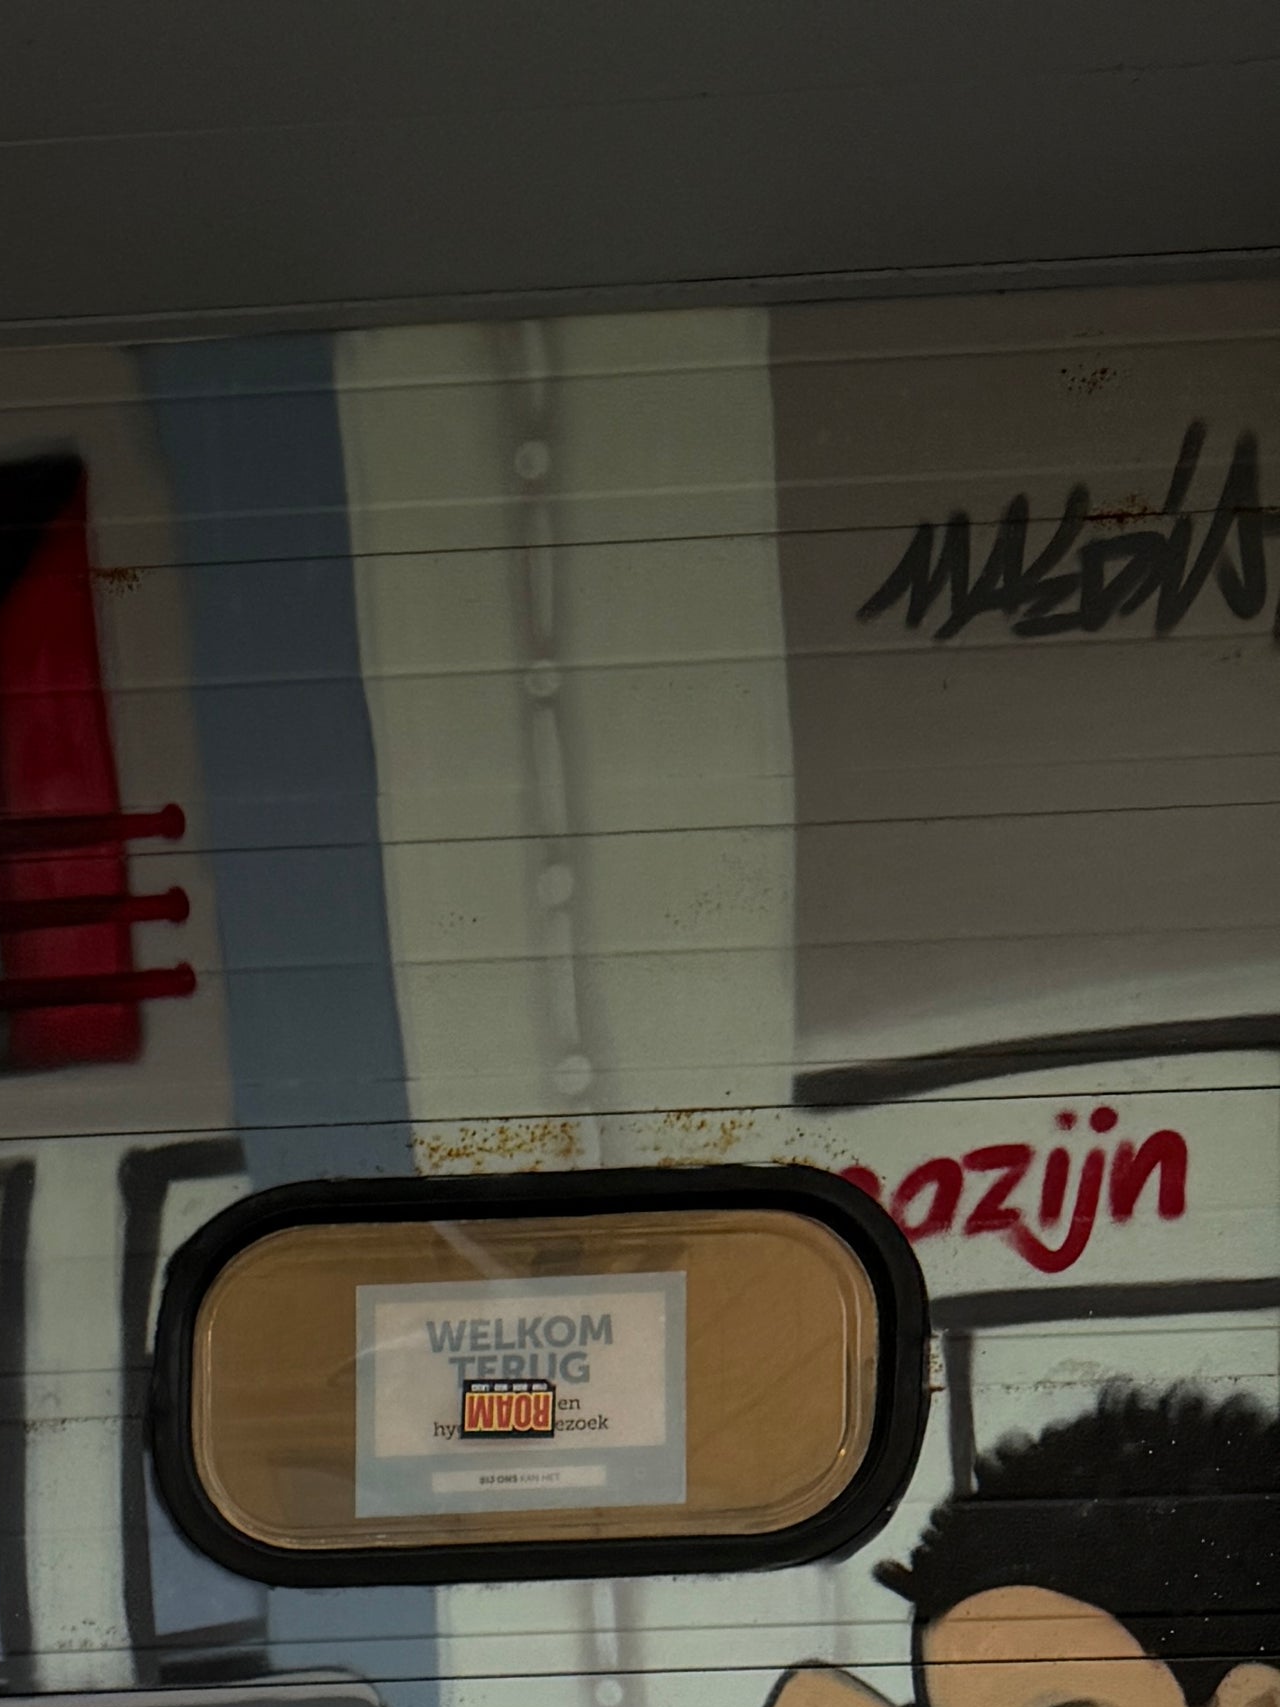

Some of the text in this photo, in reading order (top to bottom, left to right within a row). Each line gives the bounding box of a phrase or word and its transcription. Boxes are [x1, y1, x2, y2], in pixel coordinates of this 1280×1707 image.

[426, 1314, 614, 1354] WELKOM
[464, 1392, 553, 1431] ROAM
[555, 1414, 609, 1432] ezoek
